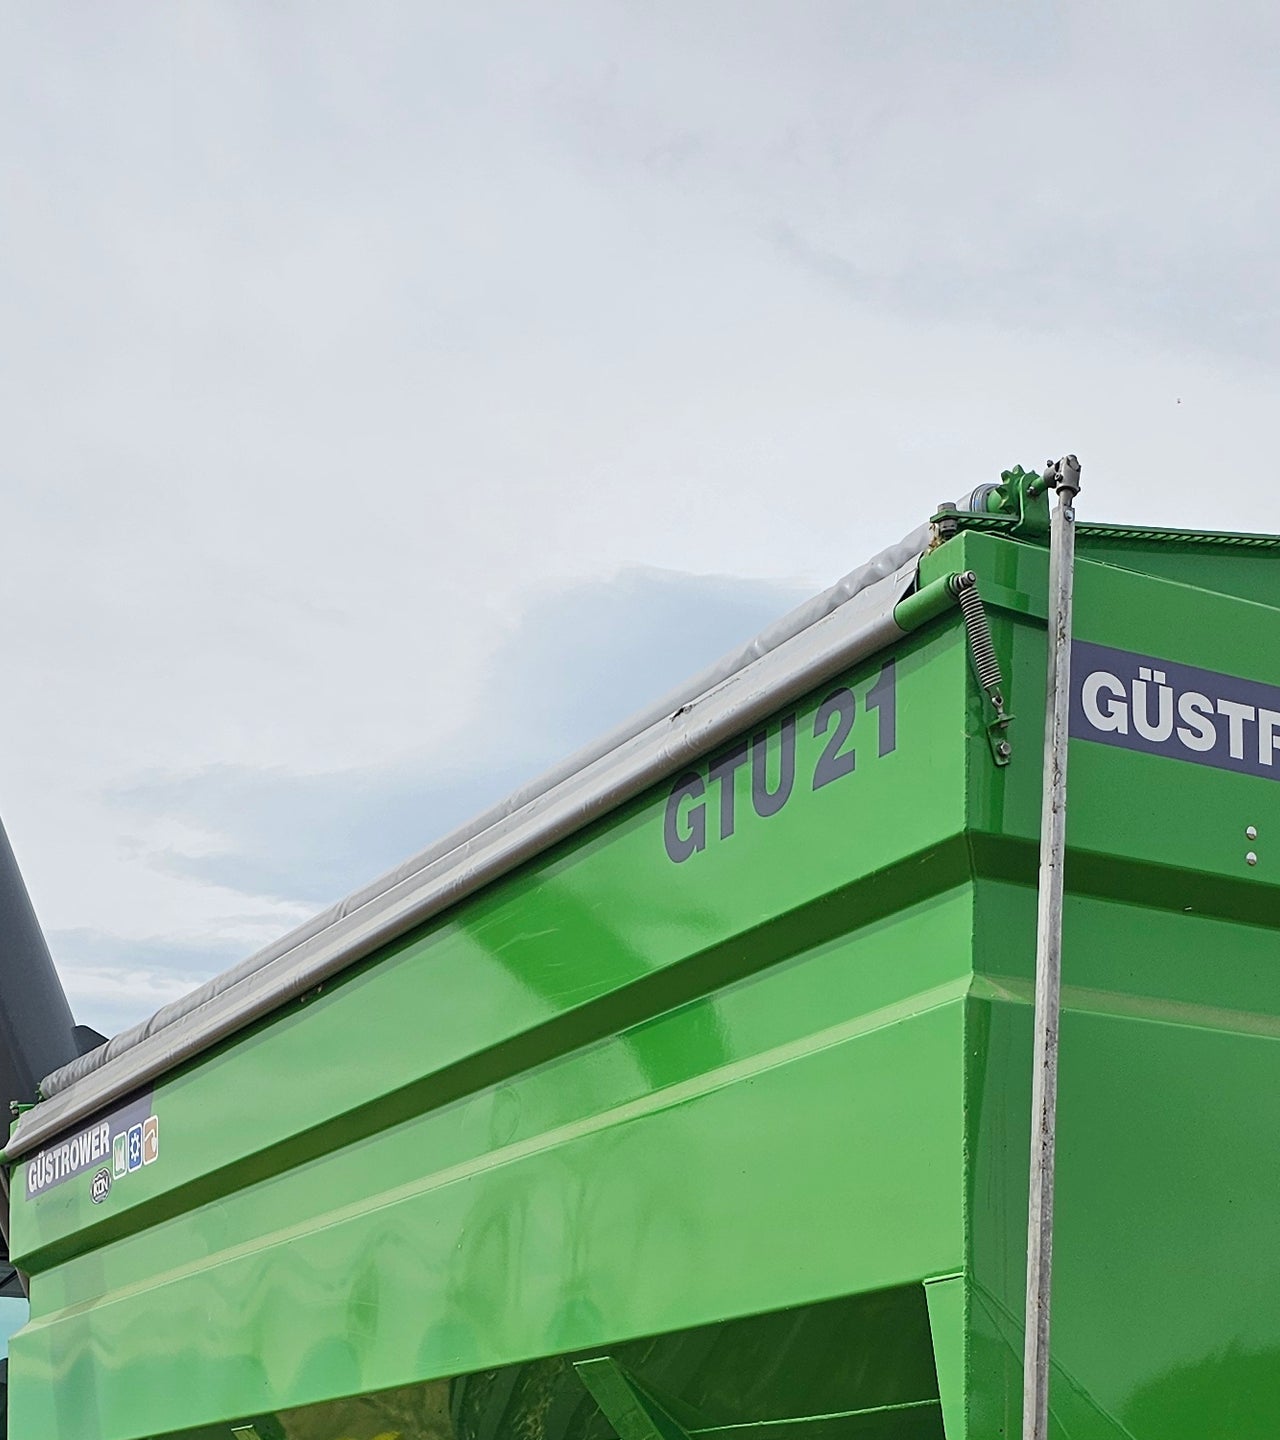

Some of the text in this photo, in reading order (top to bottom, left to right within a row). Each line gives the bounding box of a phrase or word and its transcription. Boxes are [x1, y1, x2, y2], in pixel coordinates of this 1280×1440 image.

[663, 657, 897, 864] GTU 21
[28, 1121, 110, 1194] GÜSTROWER
